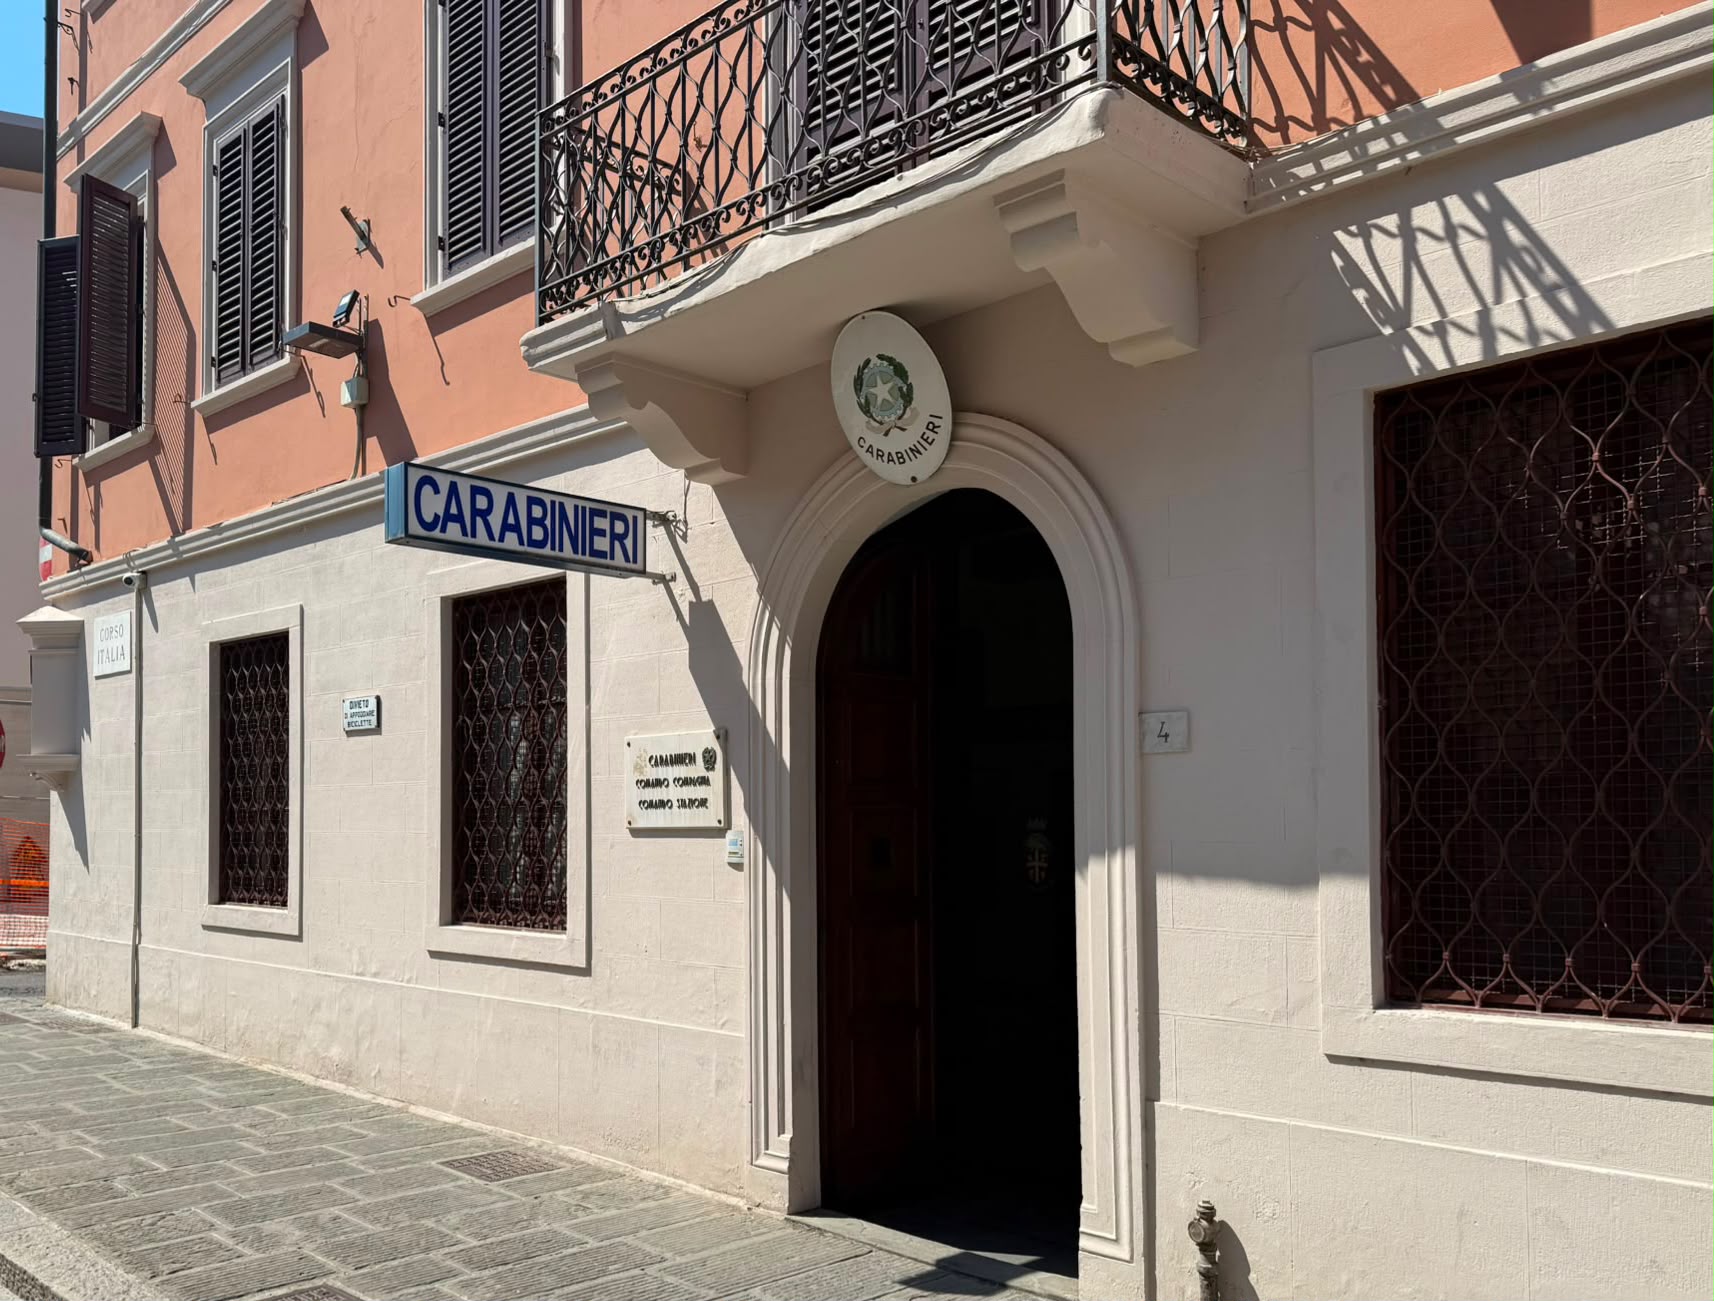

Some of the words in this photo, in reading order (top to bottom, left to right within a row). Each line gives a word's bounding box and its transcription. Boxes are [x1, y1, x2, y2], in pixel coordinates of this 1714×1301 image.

[857, 413, 943, 465] CARABINIERI
[413, 474, 638, 565] CARABINIERI
[99, 623, 124, 642] CORSO
[97, 643, 126, 665] ITALIA
[1157, 720, 1170, 744] 4
[648, 752, 696, 768] CARABINIERI
[635, 777, 670, 789] COMANDO
[638, 798, 674, 810] COMANDO
[676, 797, 709, 810] STAZIONE
